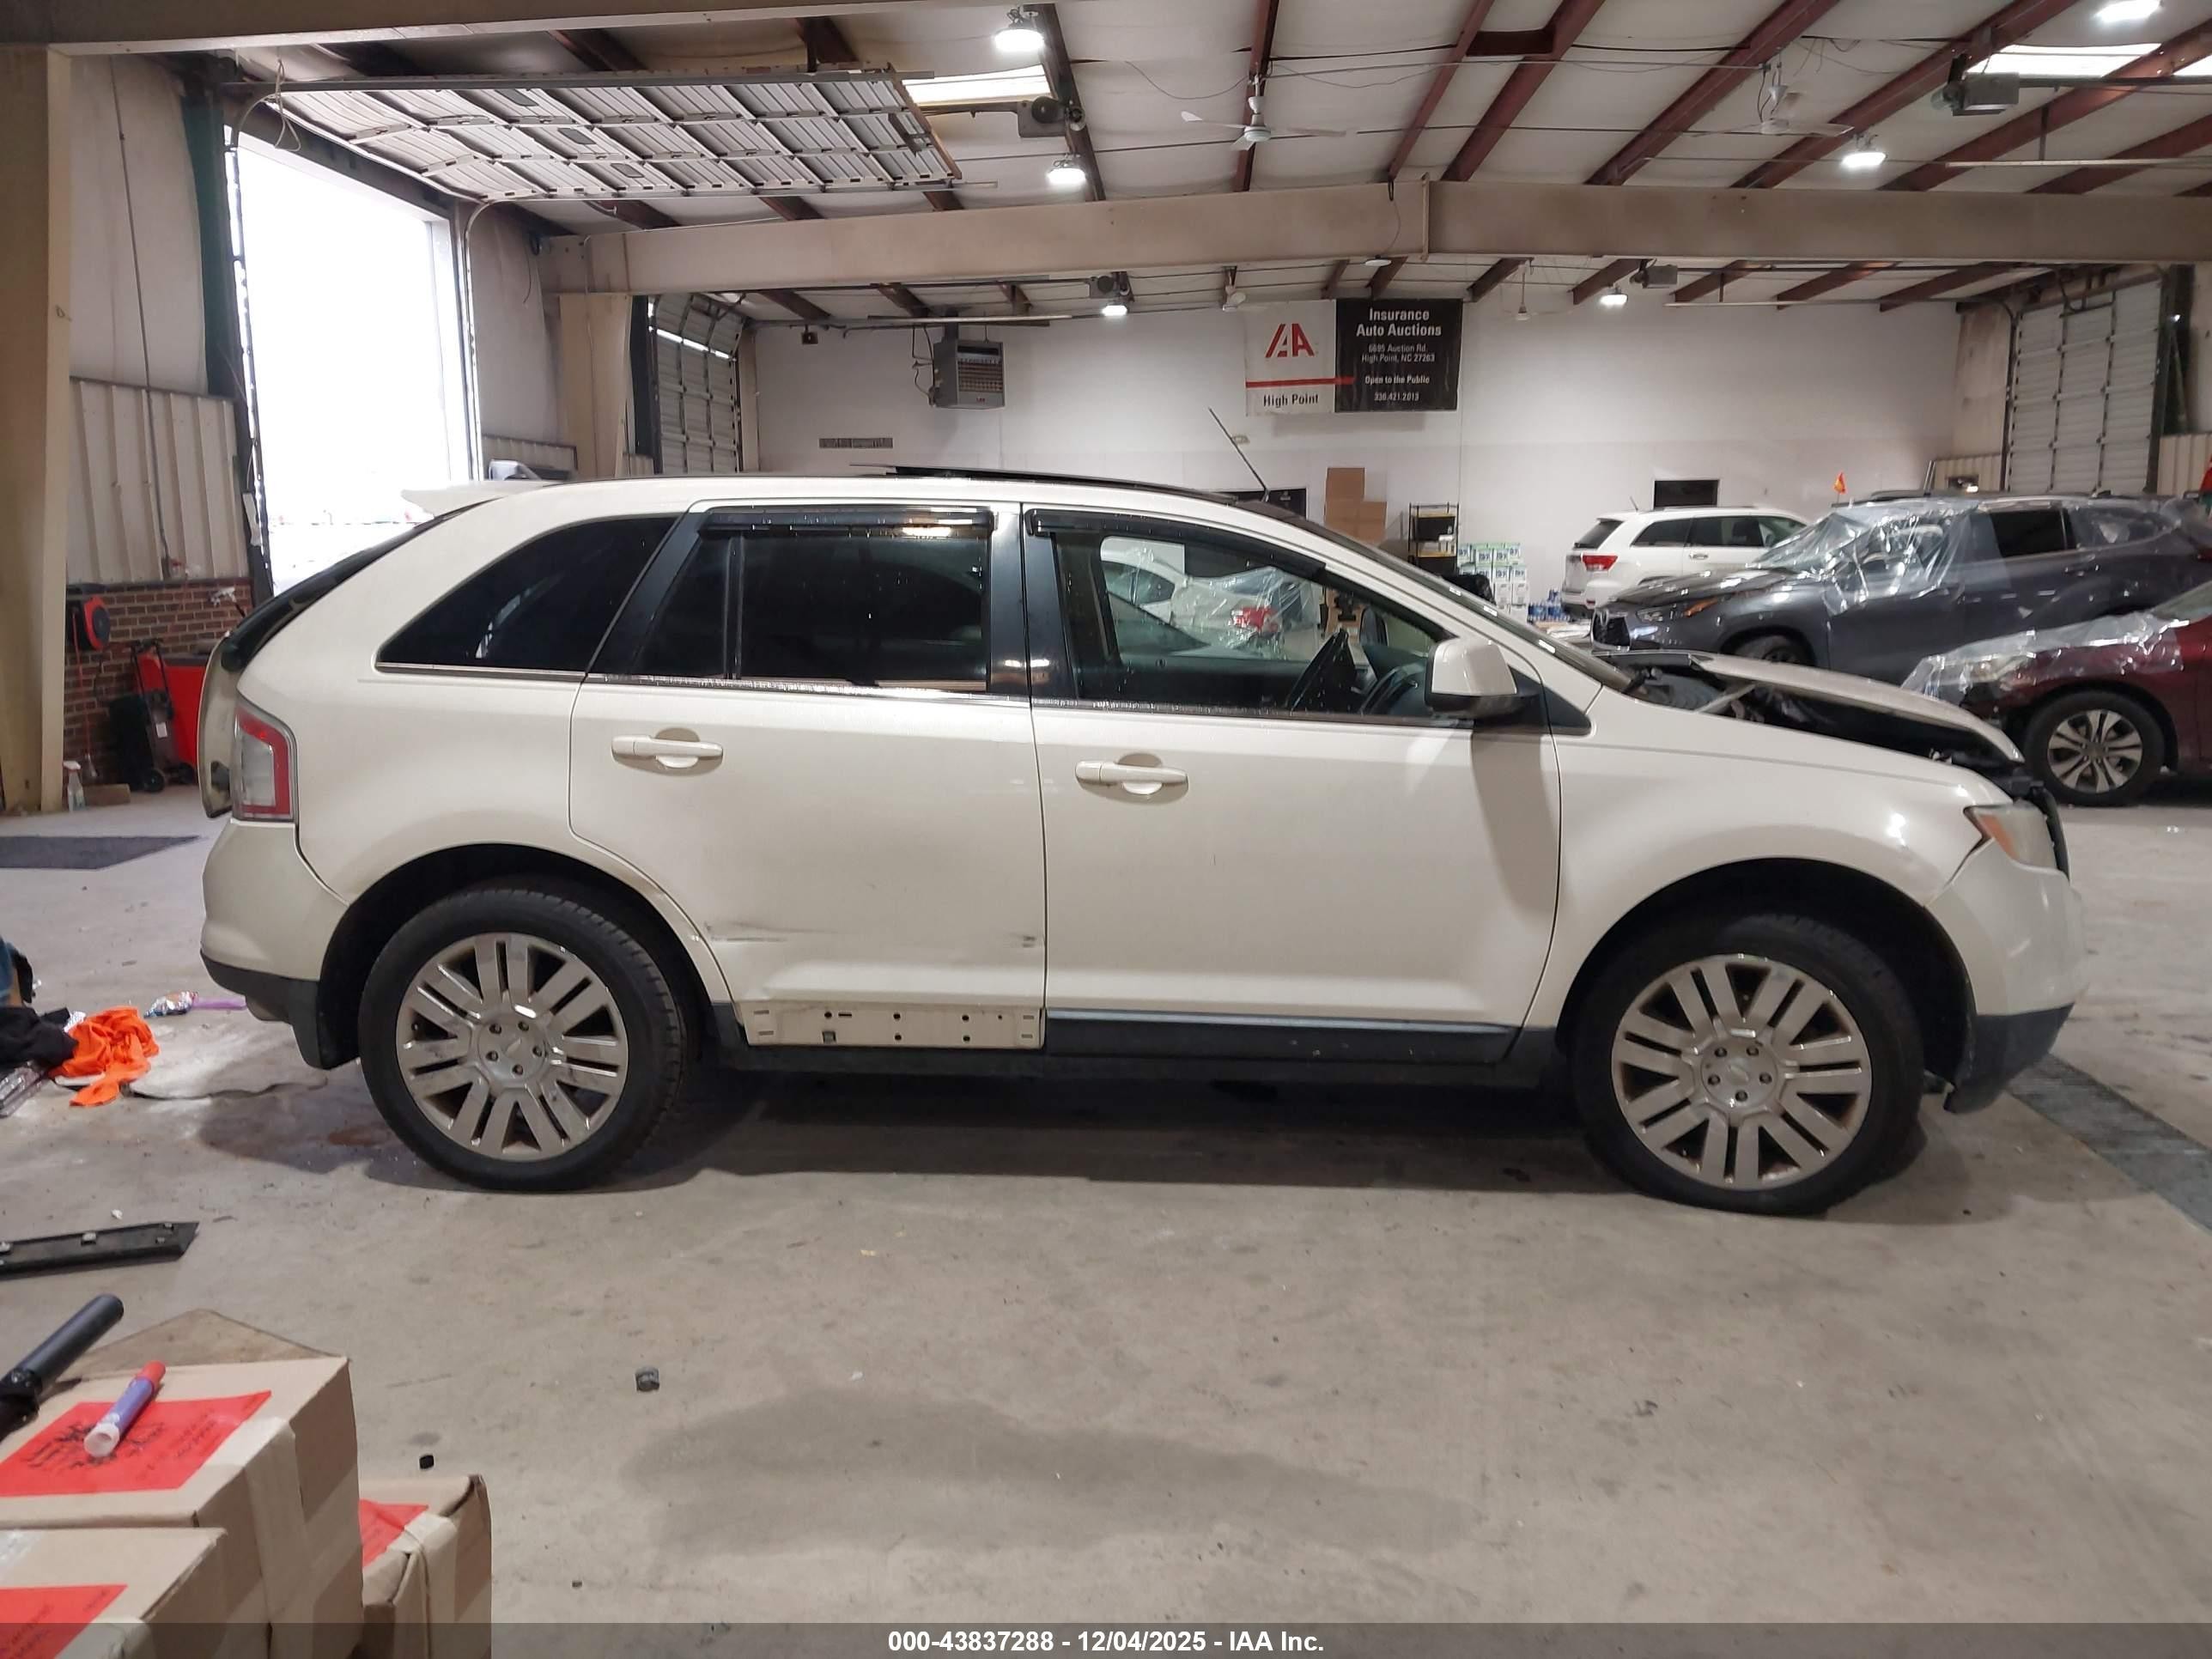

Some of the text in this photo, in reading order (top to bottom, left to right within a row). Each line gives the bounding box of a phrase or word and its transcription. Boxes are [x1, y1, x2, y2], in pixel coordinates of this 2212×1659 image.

[1369, 307, 1430, 320] Insurance
[1357, 323, 1442, 337] Auto Auctions
[1388, 343, 1414, 352] Auction
[1362, 354, 1377, 364] High
[1401, 354, 1412, 362] NC
[1365, 375, 1430, 385] Open to the Public
[1264, 393, 1318, 408] High Point
